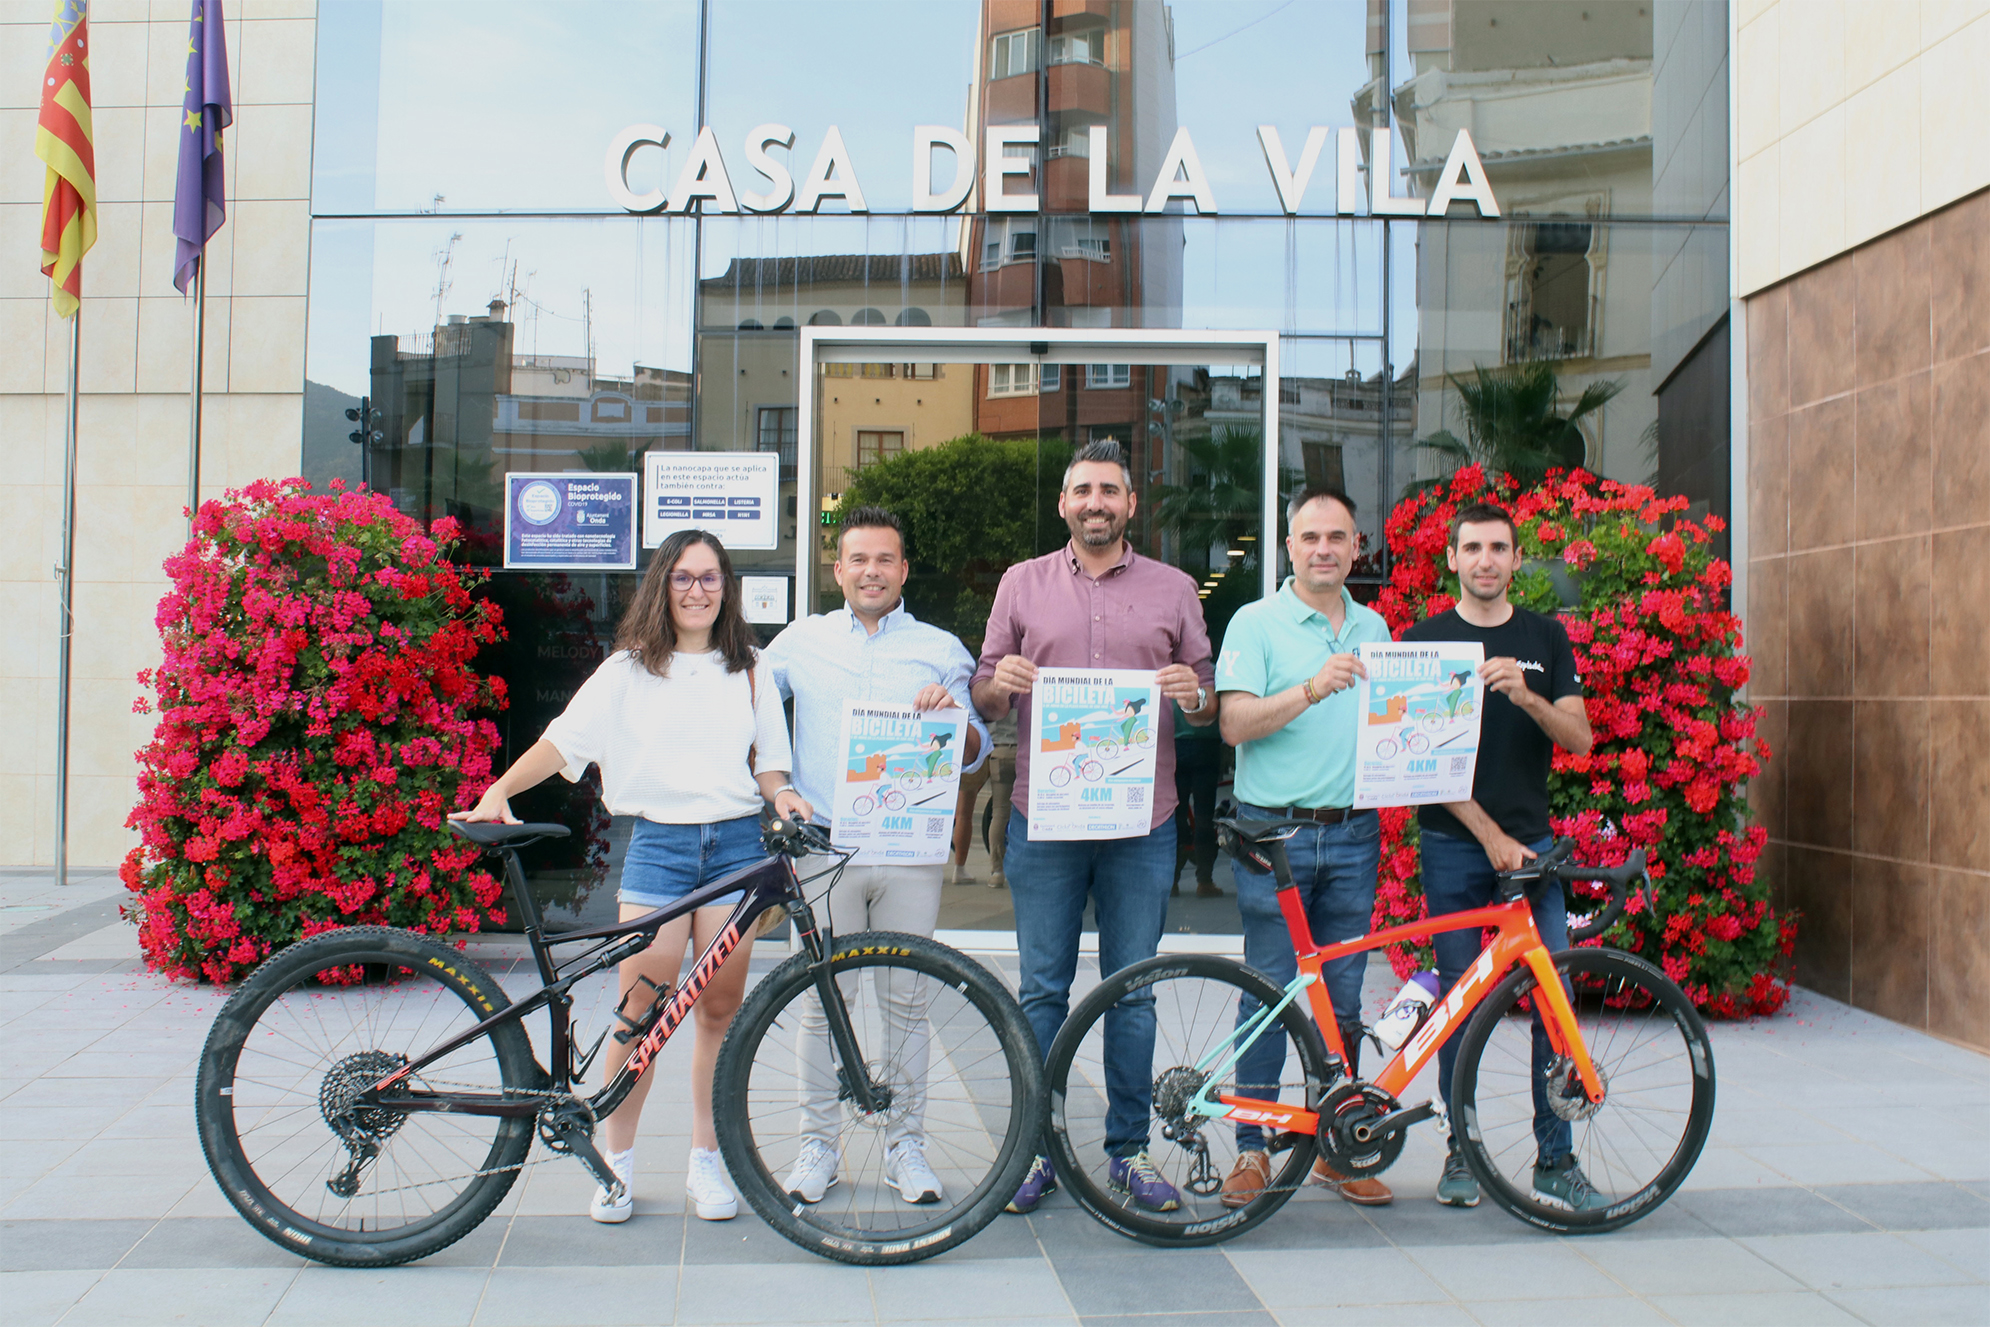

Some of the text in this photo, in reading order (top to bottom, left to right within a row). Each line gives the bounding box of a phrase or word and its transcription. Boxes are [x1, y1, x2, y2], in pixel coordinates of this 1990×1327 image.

[605, 123, 1501, 218] CASA DE LA VILA
[743, 465, 767, 473] aplica
[693, 474, 724, 482] espacio
[568, 483, 600, 492] Espacio
[568, 492, 622, 502] Bioprotegido
[538, 646, 599, 658] MELODY
[1370, 650, 1384, 659] DÍA
[1370, 659, 1442, 678] BICILETA
[1043, 676, 1056, 684] DÍA
[1058, 677, 1092, 685] MUNDIAL
[536, 690, 572, 702] MAN
[1043, 686, 1116, 705] BICILETA
[852, 709, 865, 717] DÍA
[867, 710, 901, 719] MUNDIAL
[850, 718, 923, 738] BICILETA
[1406, 759, 1437, 772] 4KM
[1081, 787, 1113, 801] 4KM
[882, 816, 913, 830] 4KM
[831, 946, 912, 962] MAXXIS
[428, 957, 494, 1012] MAXXIS
[628, 922, 740, 1082] SPECIALIZED
[1402, 948, 1494, 1073] BH
[1228, 1106, 1294, 1124] BH
